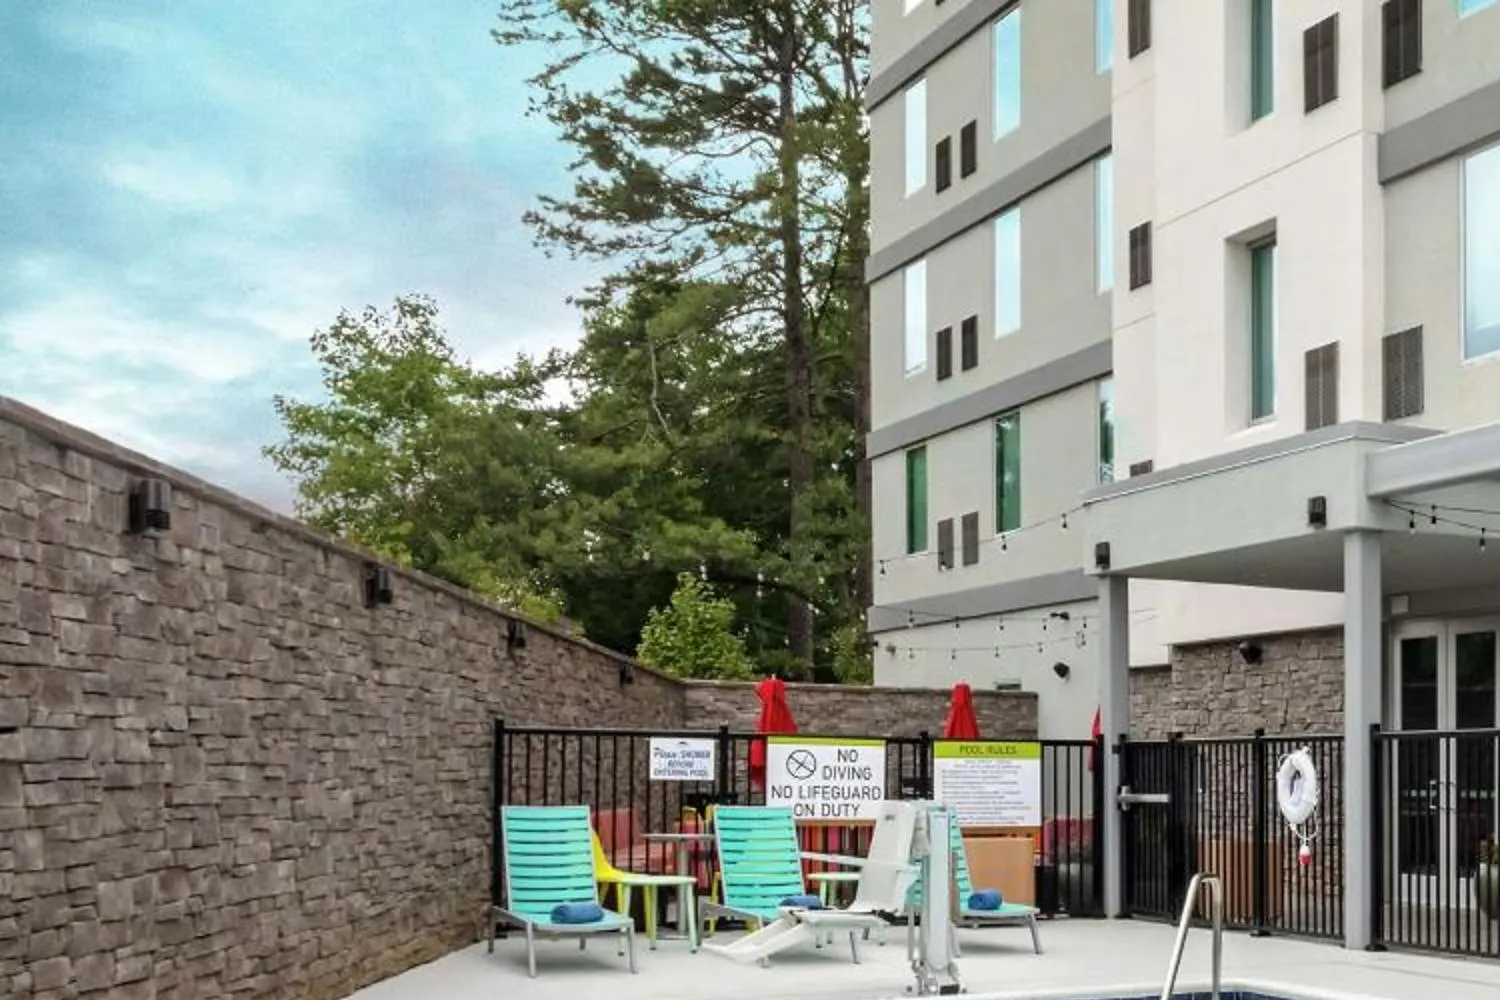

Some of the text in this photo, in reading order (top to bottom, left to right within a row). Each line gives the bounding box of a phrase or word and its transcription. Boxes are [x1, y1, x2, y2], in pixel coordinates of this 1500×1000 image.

[838, 748, 858, 762] NO
[960, 746, 1016, 754] POOL RULES
[822, 766, 872, 780] DIVING
[771, 785, 881, 800] NO LIFEGUARD
[794, 803, 860, 817] ON DUTY
